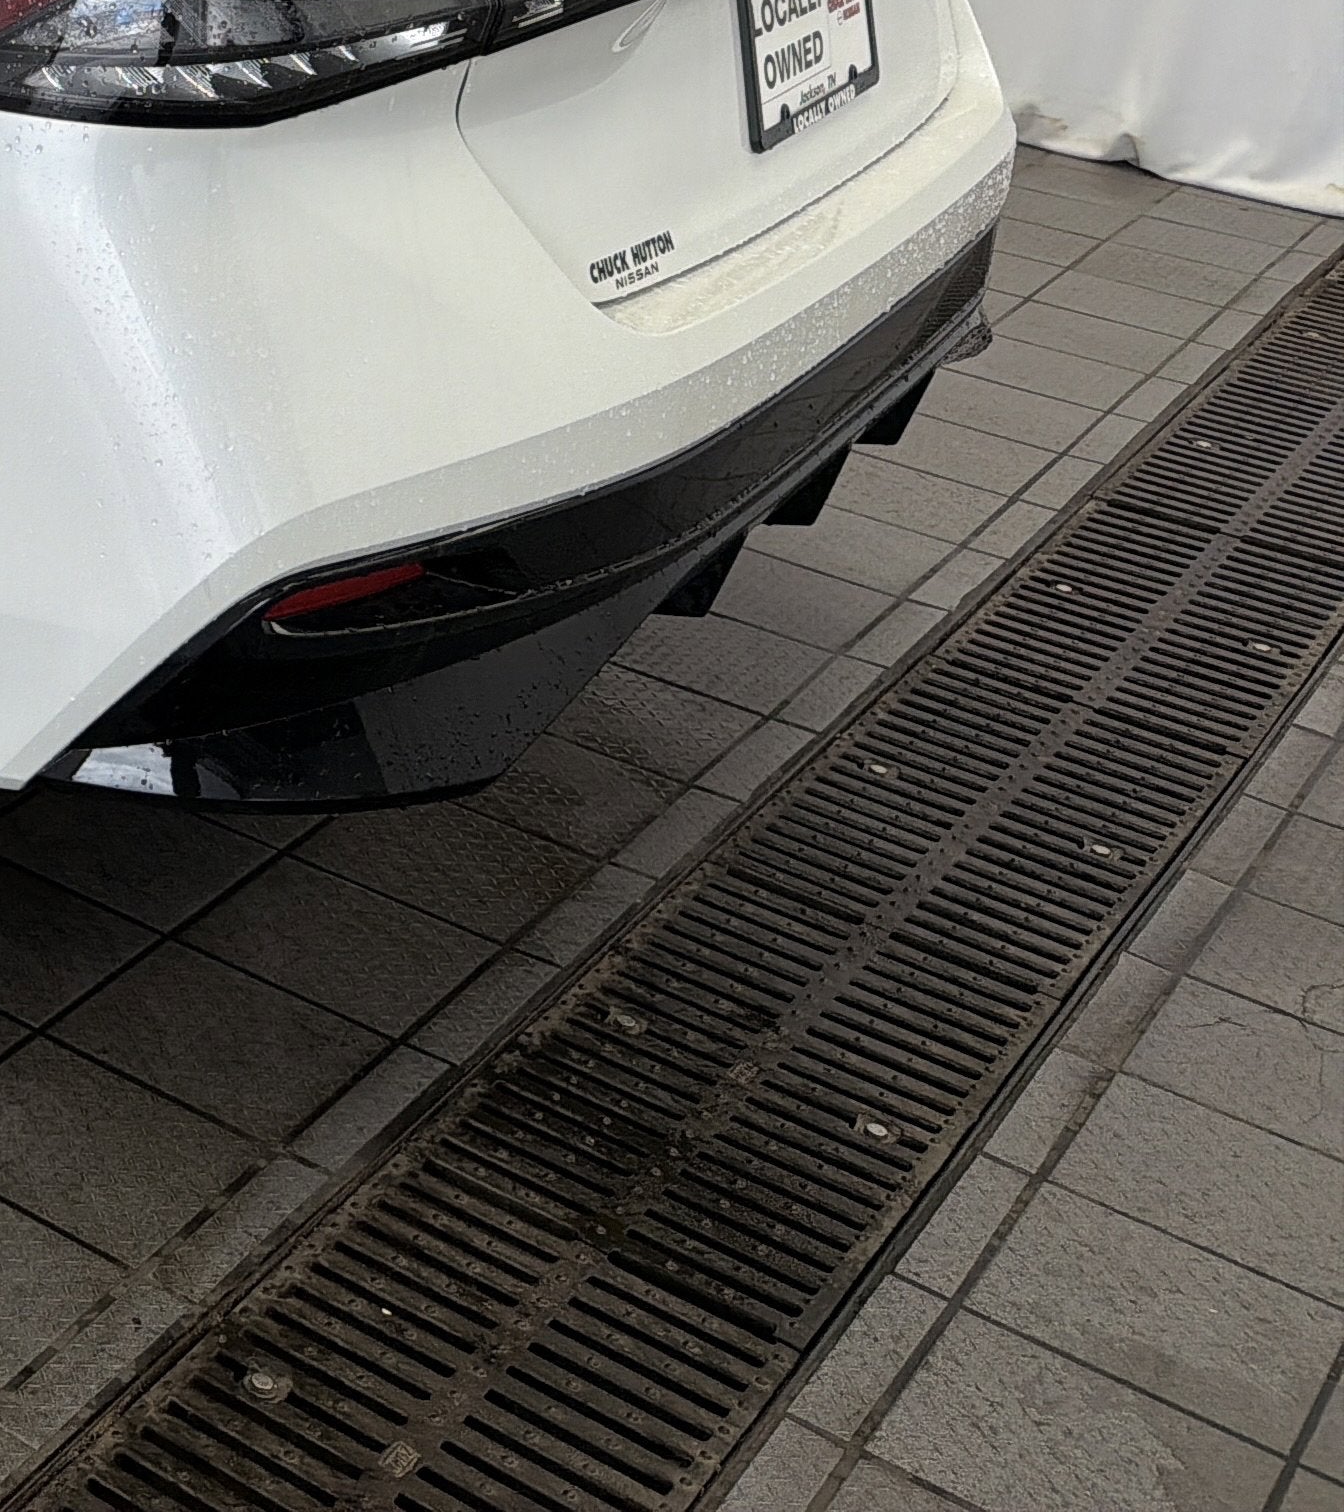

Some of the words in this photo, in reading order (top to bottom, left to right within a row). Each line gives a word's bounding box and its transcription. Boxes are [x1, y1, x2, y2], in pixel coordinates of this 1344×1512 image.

[763, 29, 824, 90] OWNED
[793, 99, 826, 135] LOCALLY
[828, 83, 856, 115] OWNED
[589, 249, 630, 284] CHUCK
[630, 229, 675, 268] HUTTON
[615, 261, 660, 290] NISSAN
